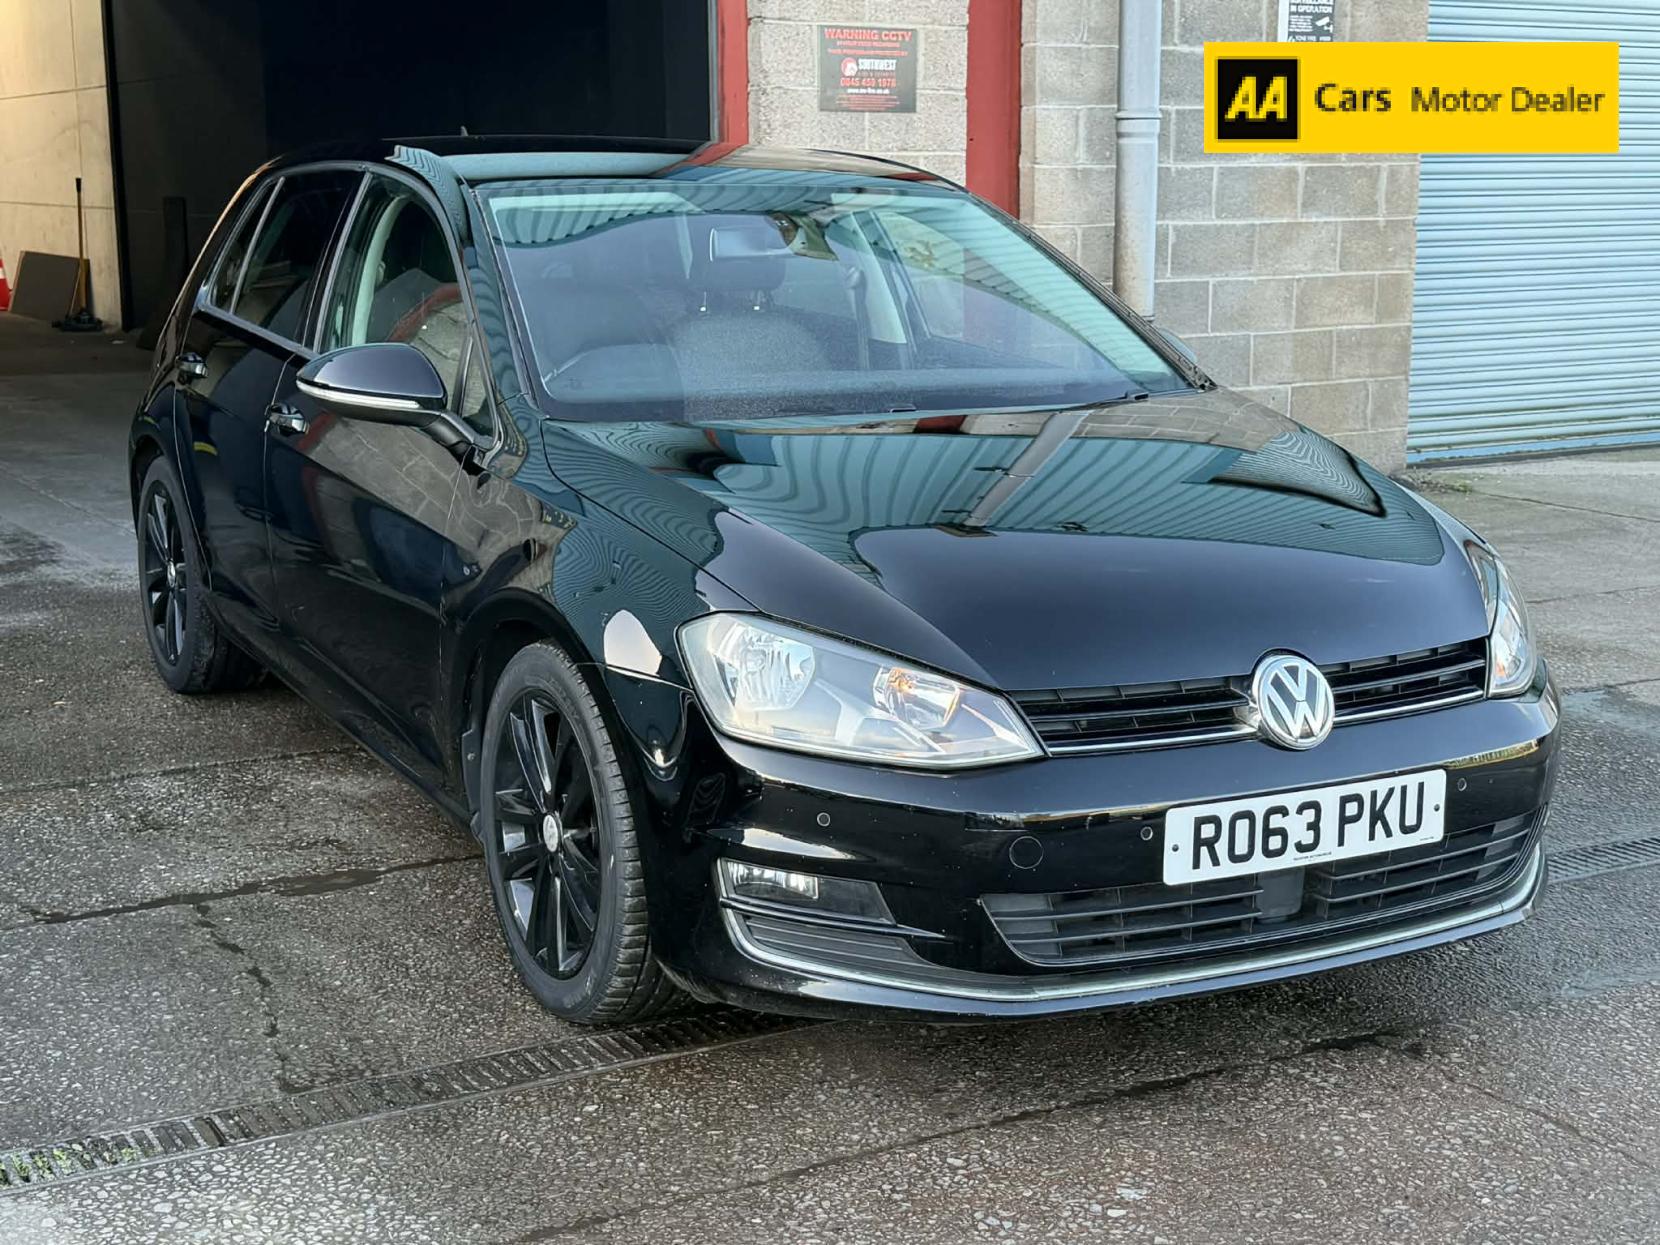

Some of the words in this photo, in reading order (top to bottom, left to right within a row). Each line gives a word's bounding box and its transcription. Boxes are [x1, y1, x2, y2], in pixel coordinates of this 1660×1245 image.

[824, 28, 879, 40] WARNING
[881, 31, 912, 42] CCTV
[1192, 800, 1322, 870] RO63
[1337, 781, 1425, 848] PKU
